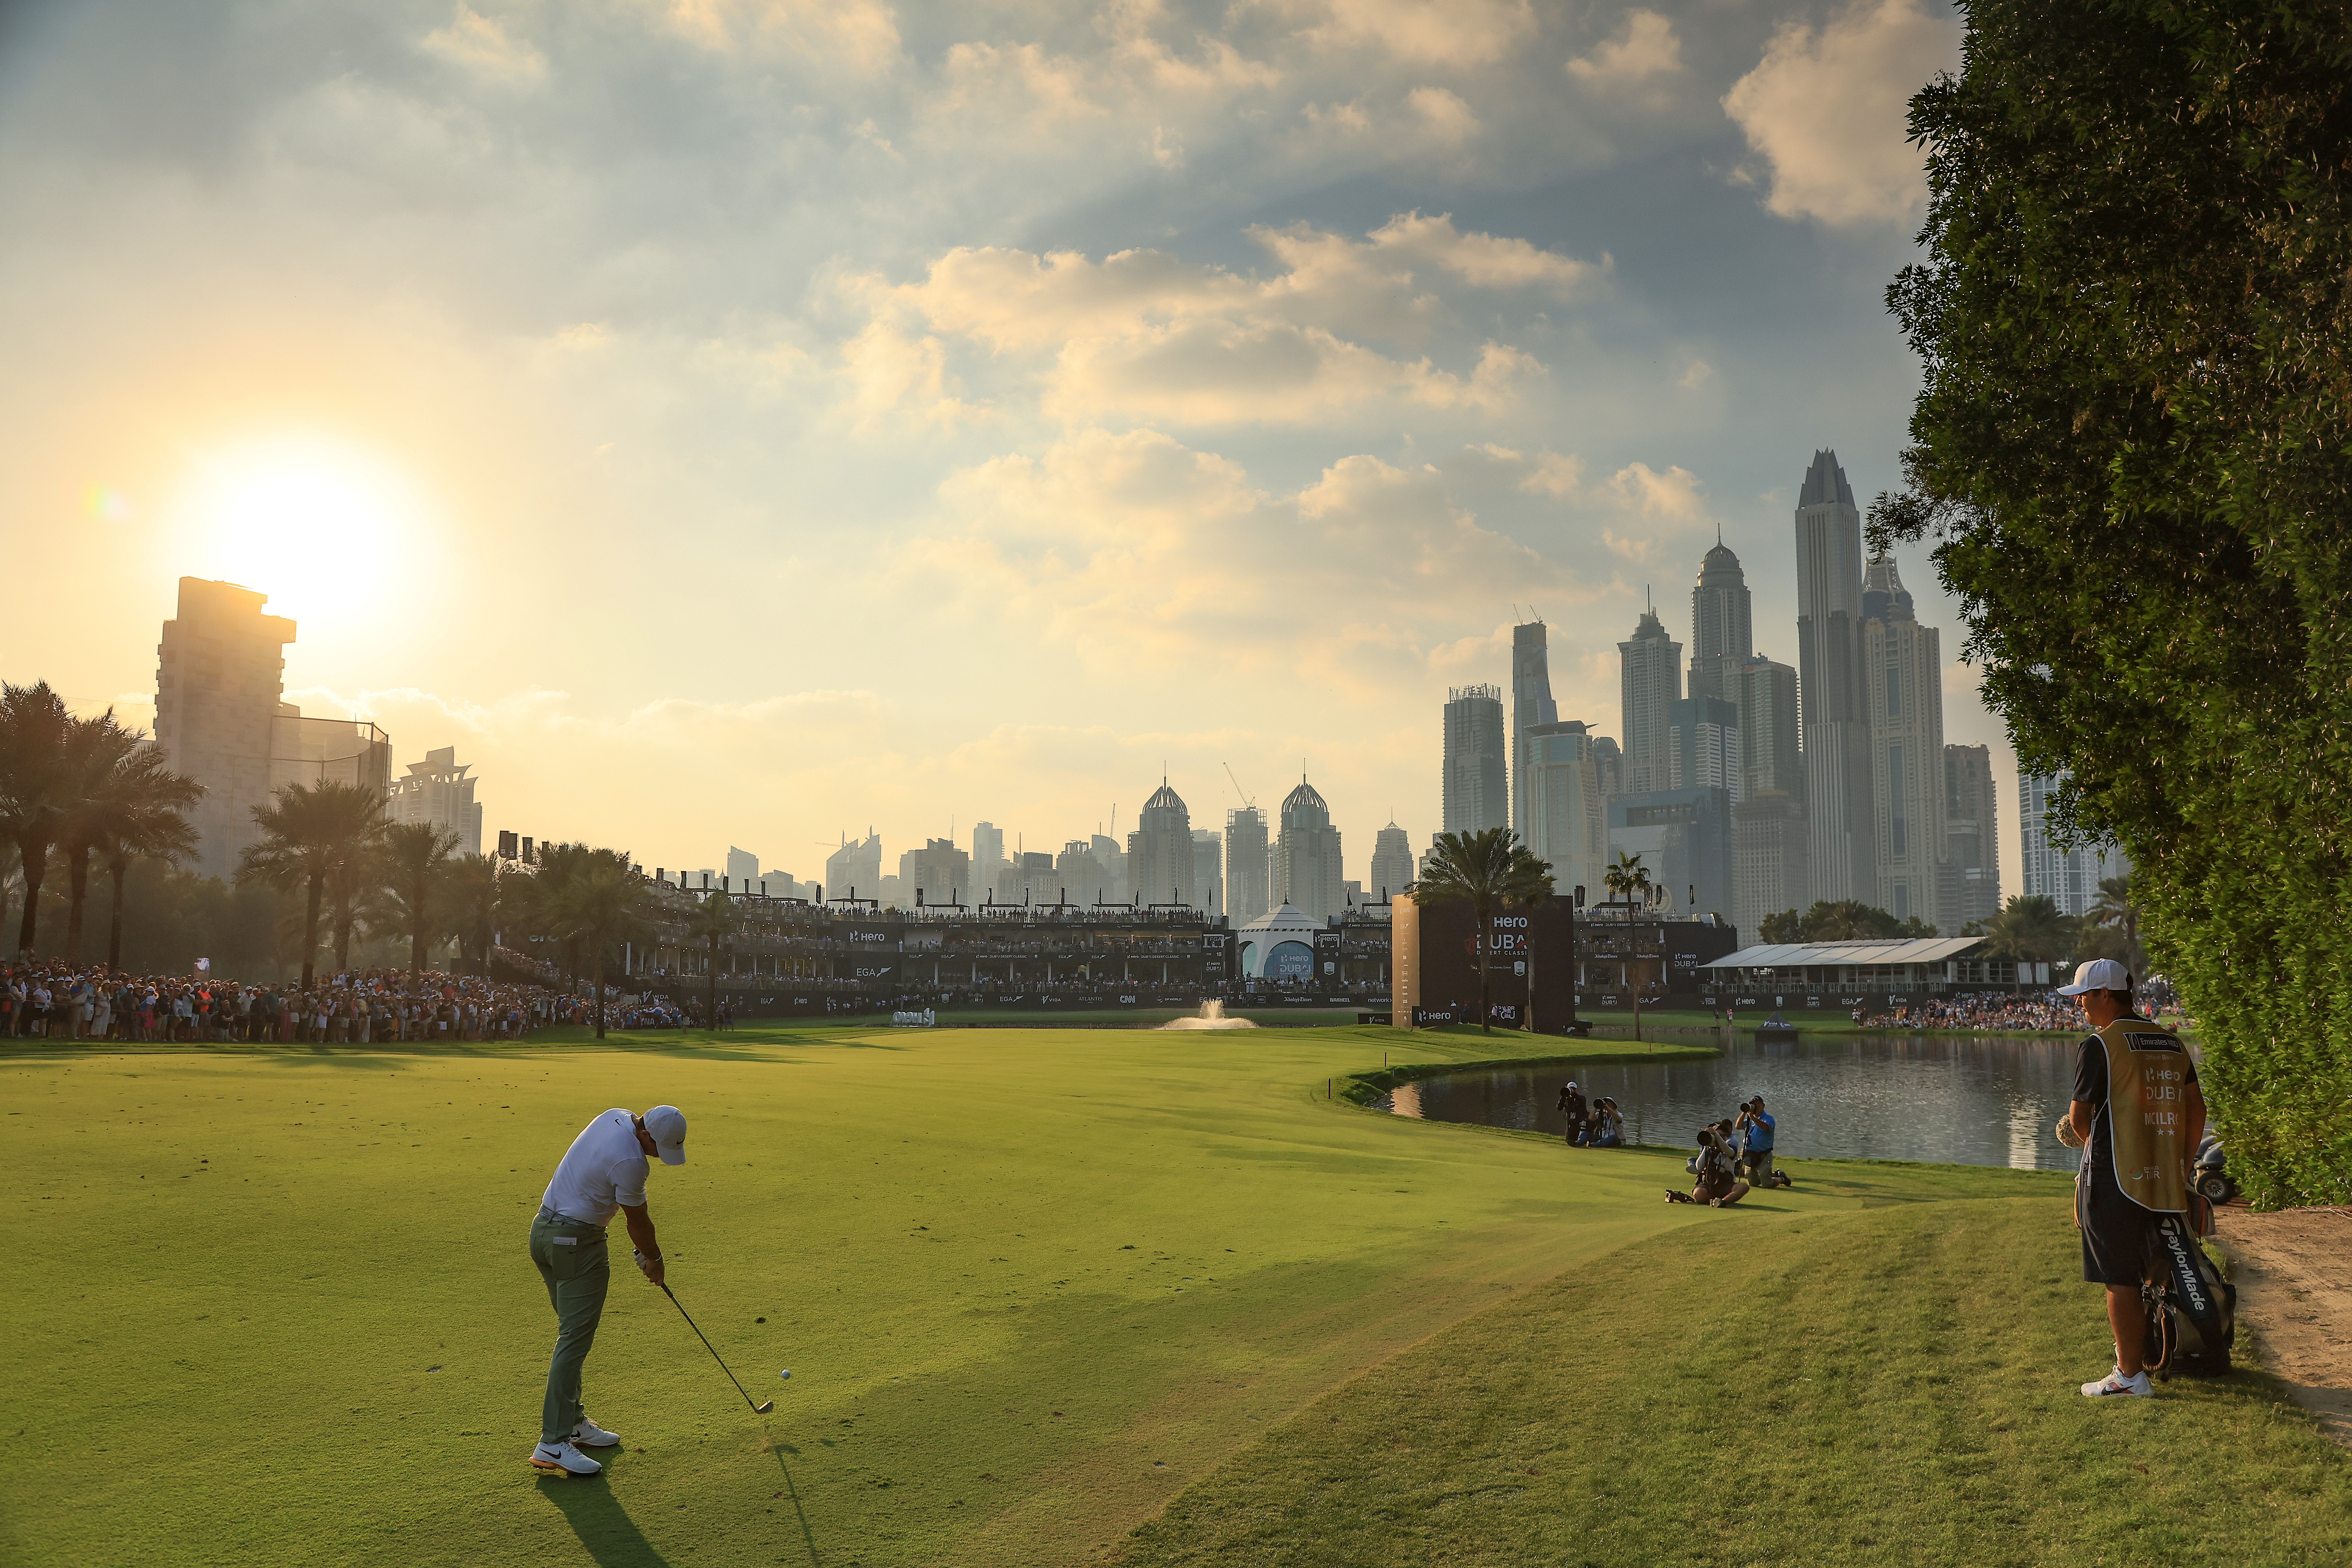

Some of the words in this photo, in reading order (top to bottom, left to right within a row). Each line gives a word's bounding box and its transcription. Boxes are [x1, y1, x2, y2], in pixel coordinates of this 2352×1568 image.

[1494, 917, 1528, 928] Hero
[861, 933, 885, 941] Hero
[857, 968, 875, 976] EGA
[2146, 1086, 2181, 1102] DUBI
[2161, 1218, 2206, 1311] TaylorMade
